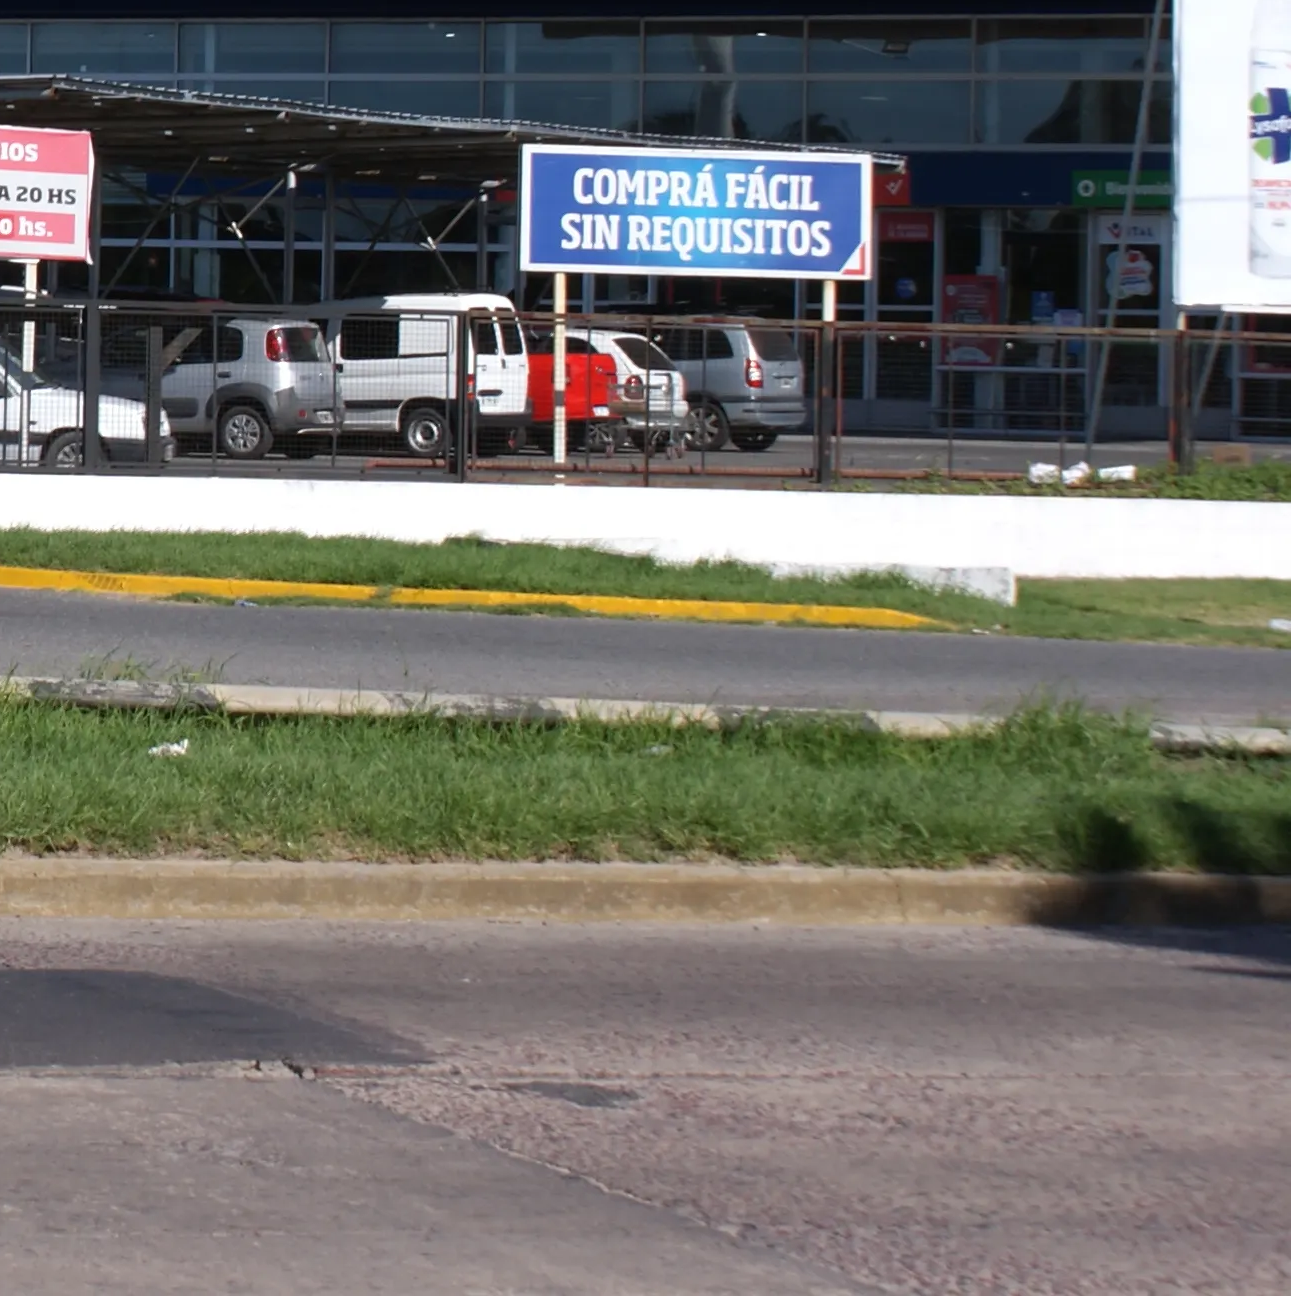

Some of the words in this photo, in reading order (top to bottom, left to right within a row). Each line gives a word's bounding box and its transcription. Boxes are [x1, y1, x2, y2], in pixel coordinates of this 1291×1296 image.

[15, 185, 43, 204] 20
[47, 187, 76, 206] HS
[572, 163, 719, 209] COMPRÁ
[725, 165, 820, 212] FÁCIL
[18, 215, 54, 238] hs.
[560, 212, 621, 251] SIN
[626, 214, 832, 262] REQUISITOS
